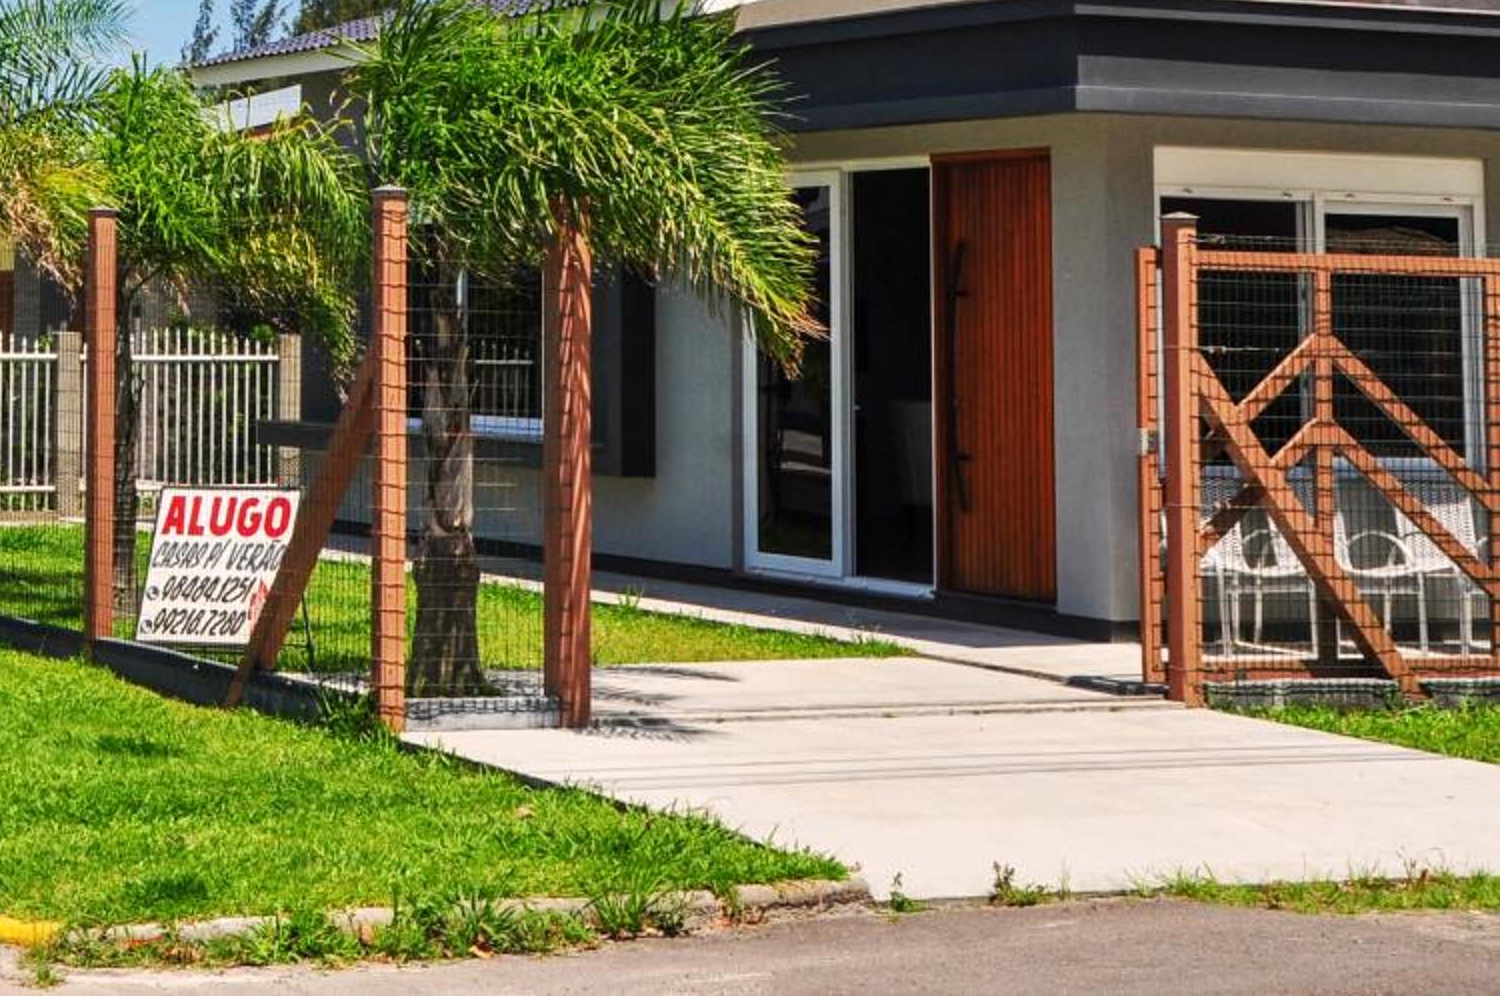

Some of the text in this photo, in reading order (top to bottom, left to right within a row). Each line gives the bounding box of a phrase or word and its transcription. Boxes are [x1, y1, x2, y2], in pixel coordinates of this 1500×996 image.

[161, 495, 292, 538] ALUGO
[152, 541, 203, 569] CASAS
[225, 540, 287, 574] VERÃO
